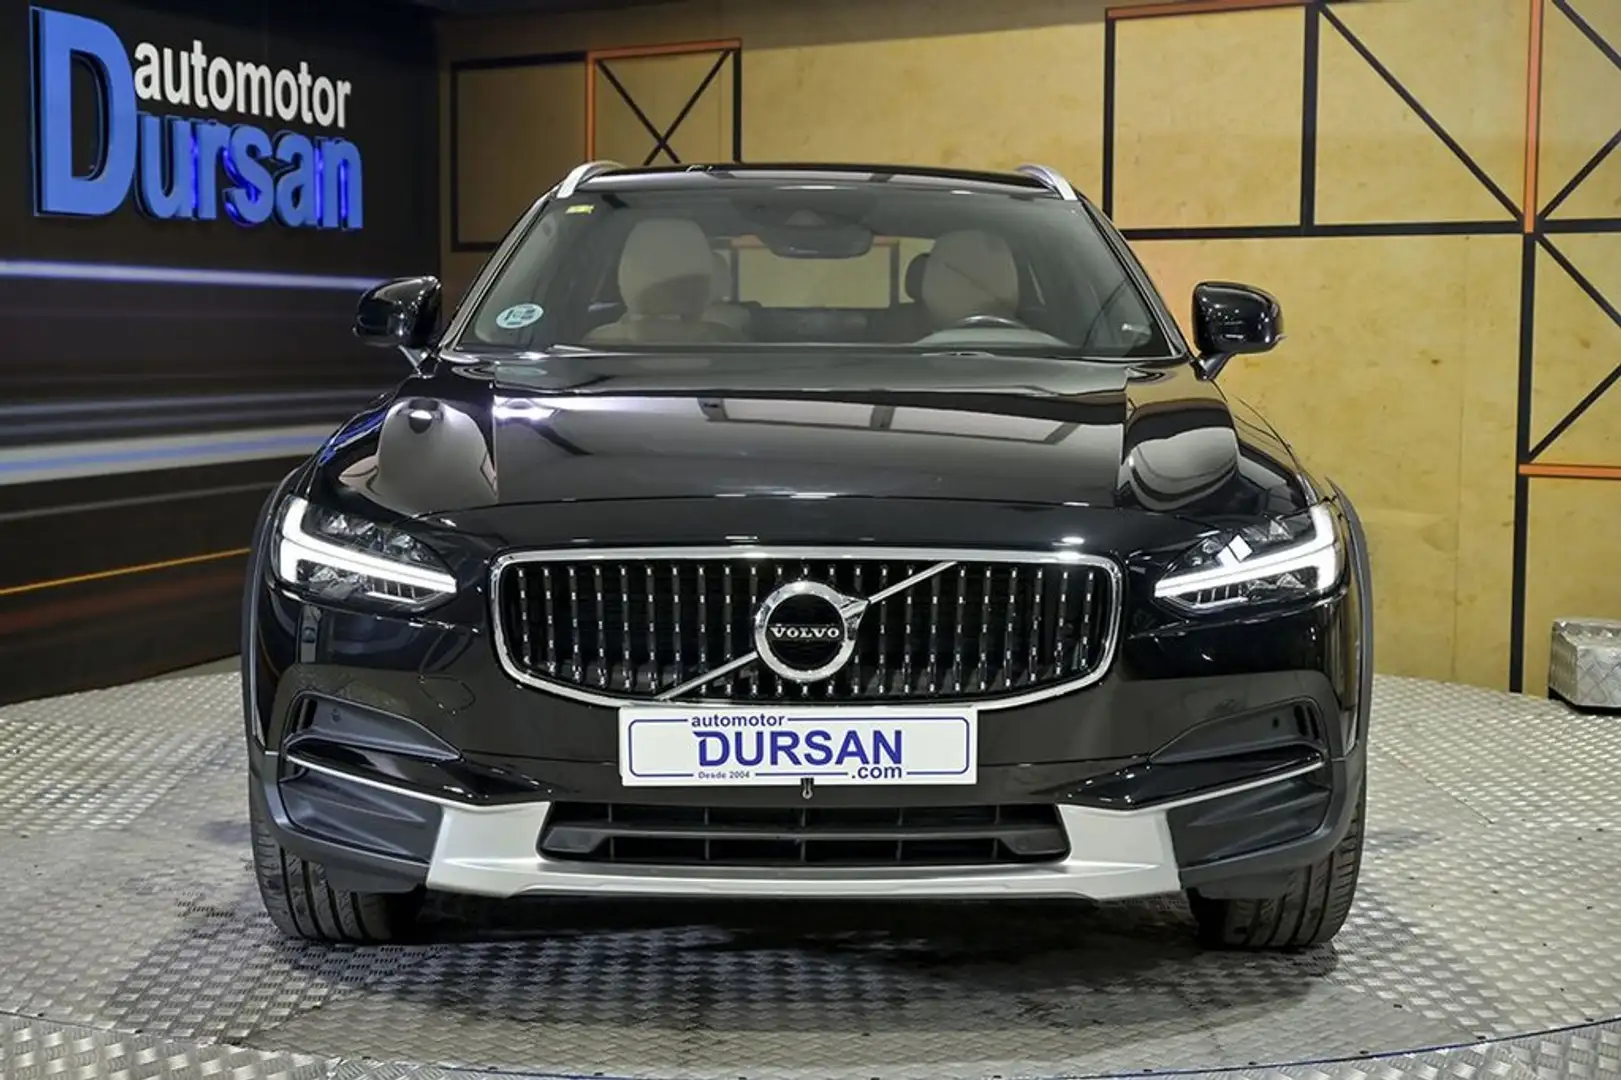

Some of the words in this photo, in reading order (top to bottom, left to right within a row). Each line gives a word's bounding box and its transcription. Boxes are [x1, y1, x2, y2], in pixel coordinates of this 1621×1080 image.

[134, 39, 351, 128] automotor
[30, 6, 364, 230] Dursan
[770, 626, 840, 638] VOLVO
[691, 713, 785, 727] automotor
[693, 730, 902, 766] DURSAN
[698, 771, 726, 779] Desde
[729, 770, 750, 779] 2004
[851, 765, 902, 779] .com
